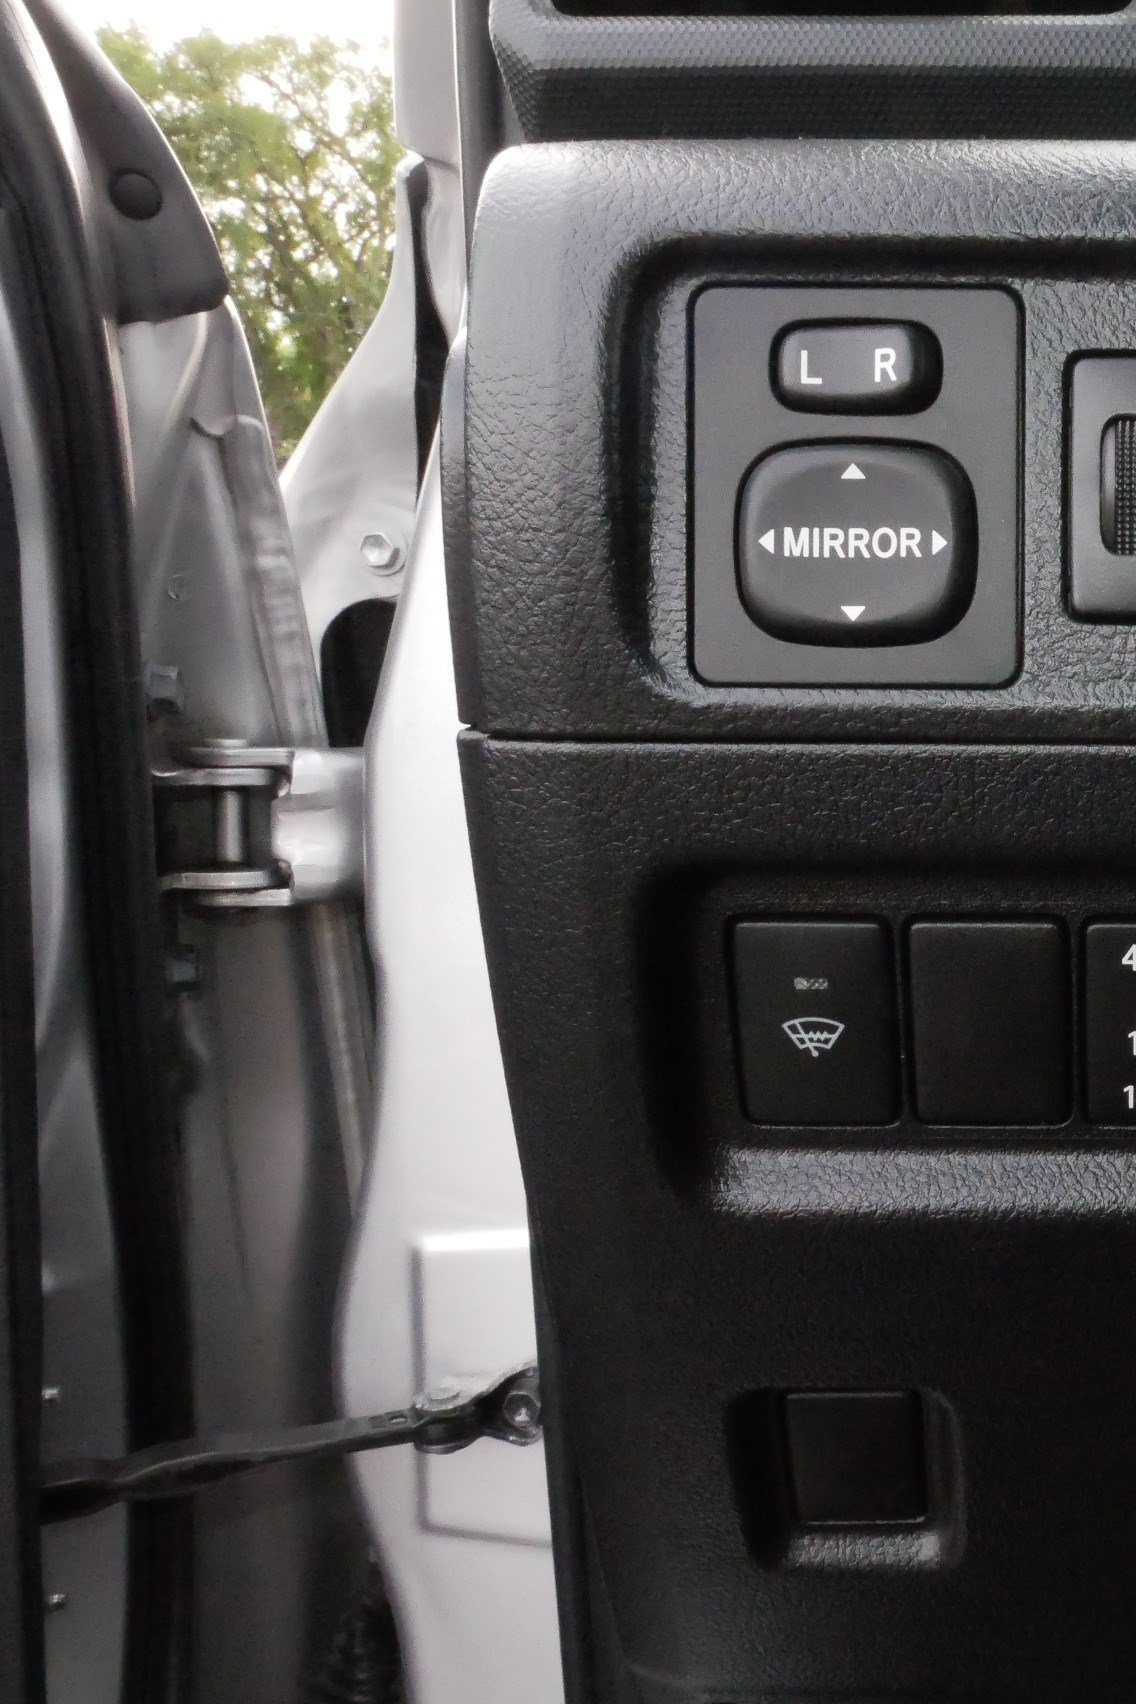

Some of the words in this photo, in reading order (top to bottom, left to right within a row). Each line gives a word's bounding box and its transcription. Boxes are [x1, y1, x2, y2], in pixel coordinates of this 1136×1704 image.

[800, 350, 823, 385] L
[874, 347, 897, 383] R
[783, 526, 922, 559] MIRROR
